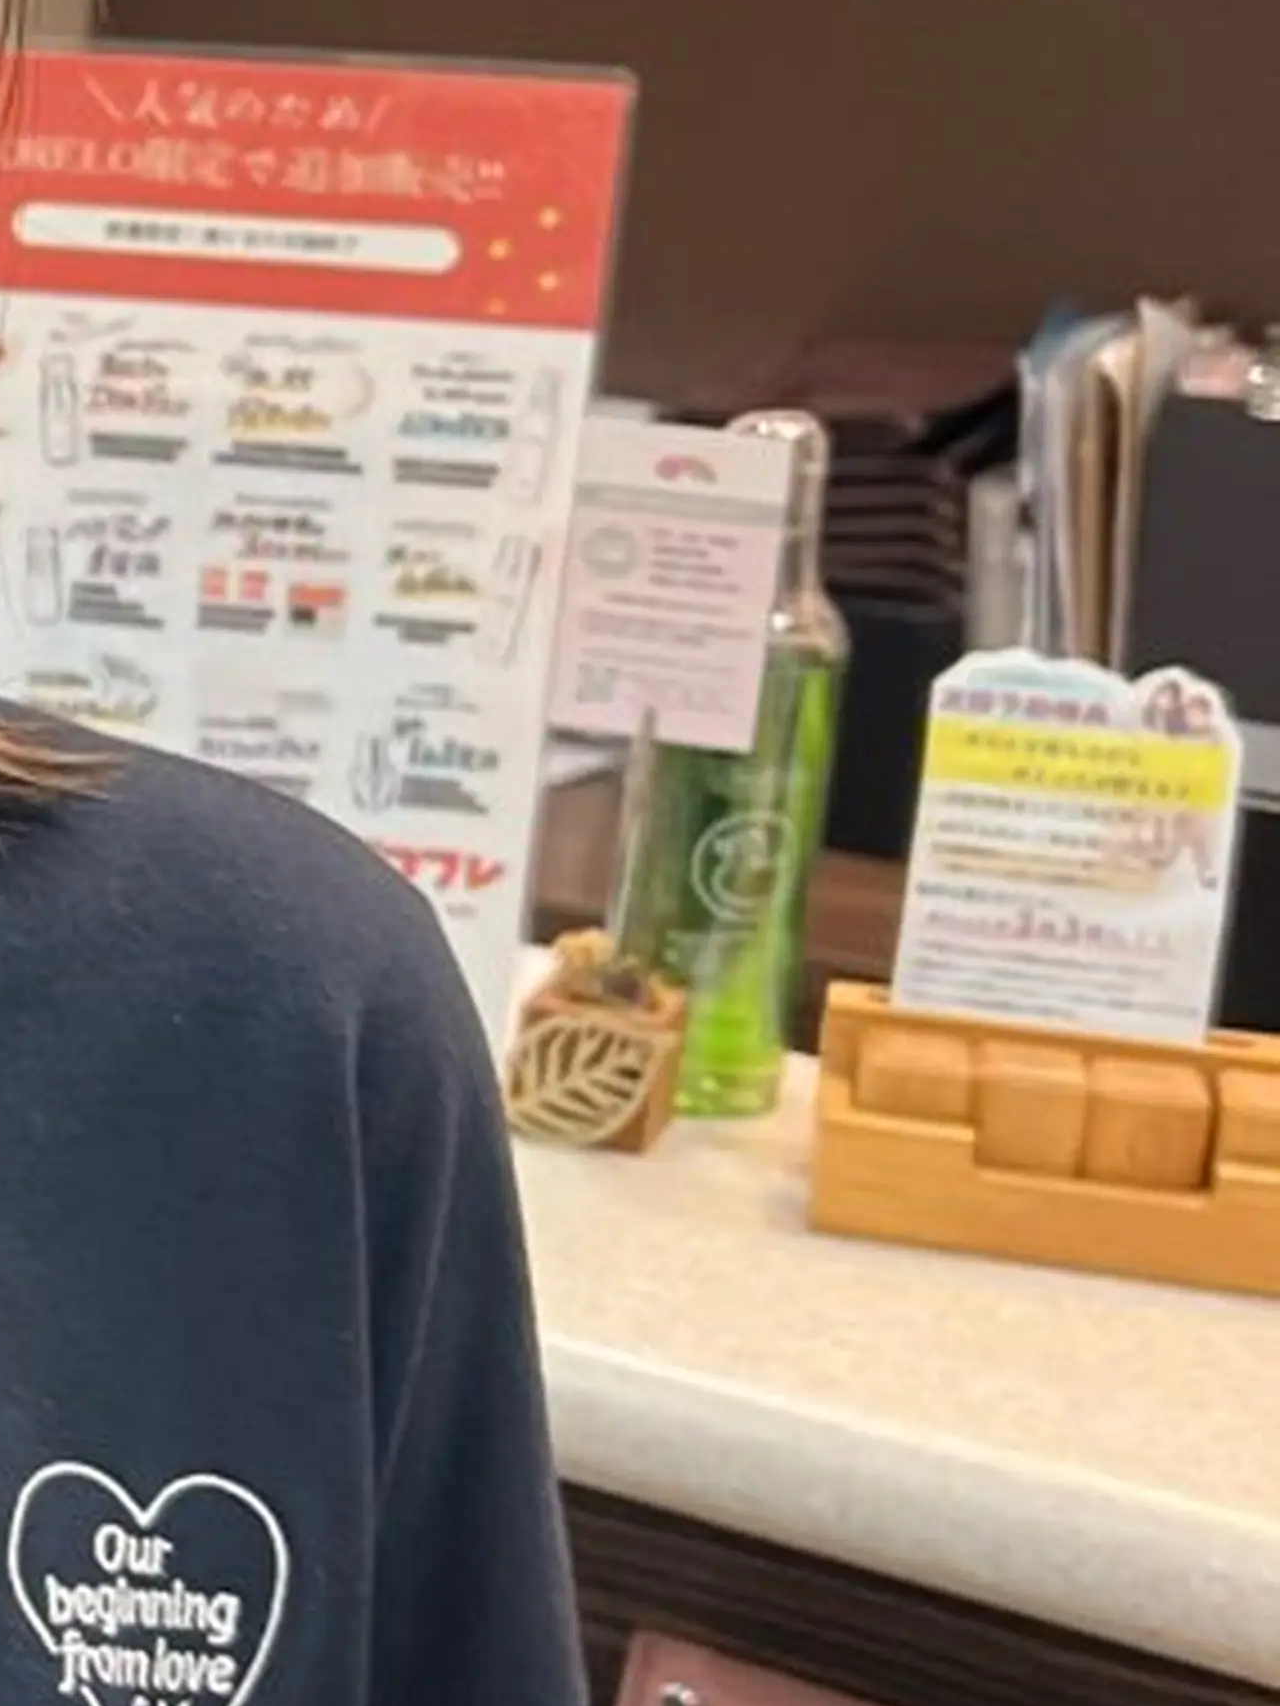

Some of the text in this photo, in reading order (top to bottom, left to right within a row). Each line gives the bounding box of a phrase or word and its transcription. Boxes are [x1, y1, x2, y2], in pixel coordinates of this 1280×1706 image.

[93, 1522, 174, 1576] Our
[45, 1573, 240, 1646] beginning
[57, 1628, 237, 1696] from love
